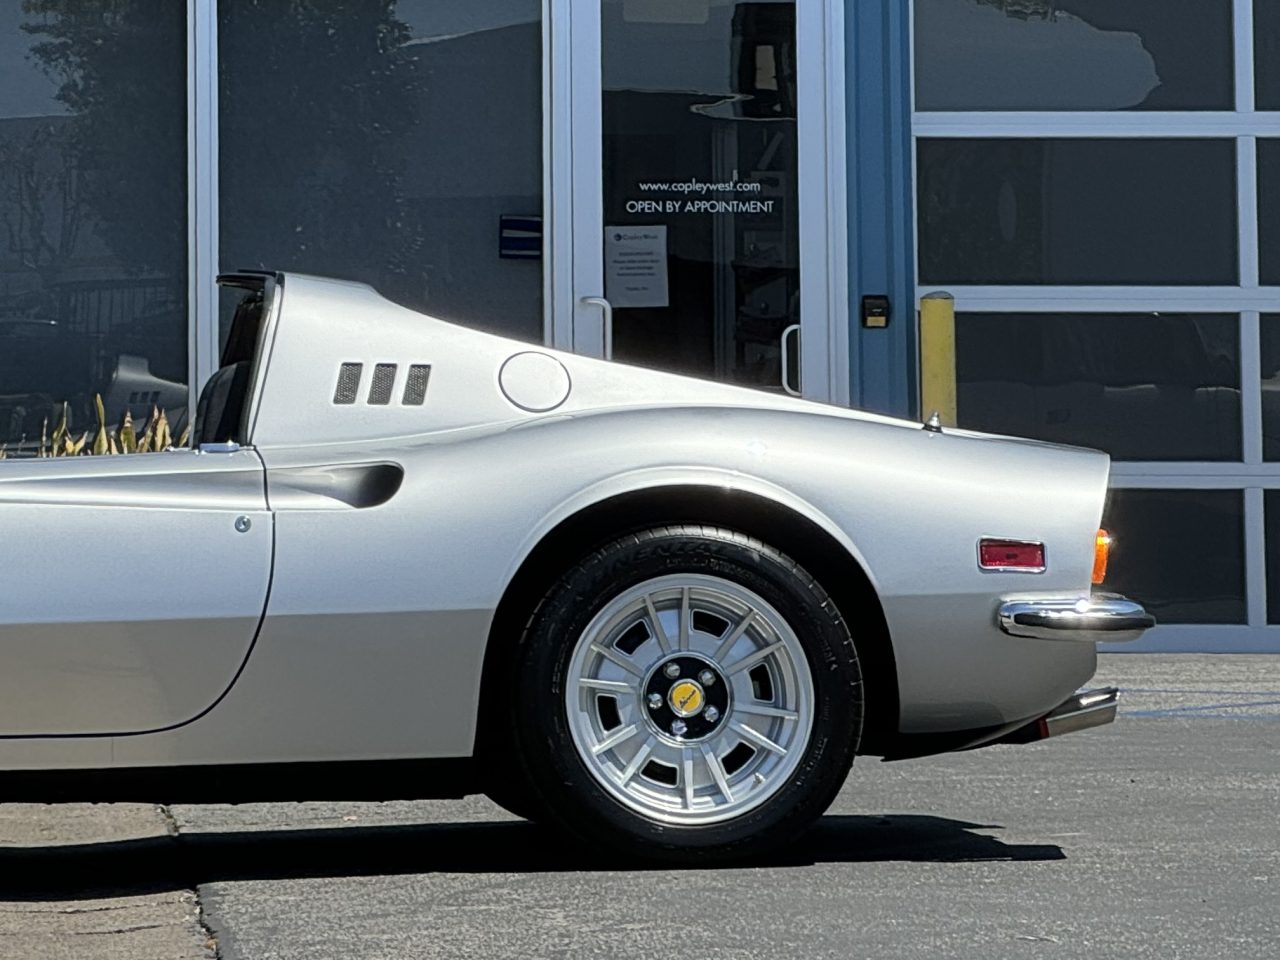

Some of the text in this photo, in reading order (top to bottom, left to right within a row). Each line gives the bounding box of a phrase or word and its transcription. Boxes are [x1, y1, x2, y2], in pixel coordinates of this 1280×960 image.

[638, 178, 762, 194] www.copleywest.com
[626, 200, 774, 213] OPEN BY APPOINTMENT
